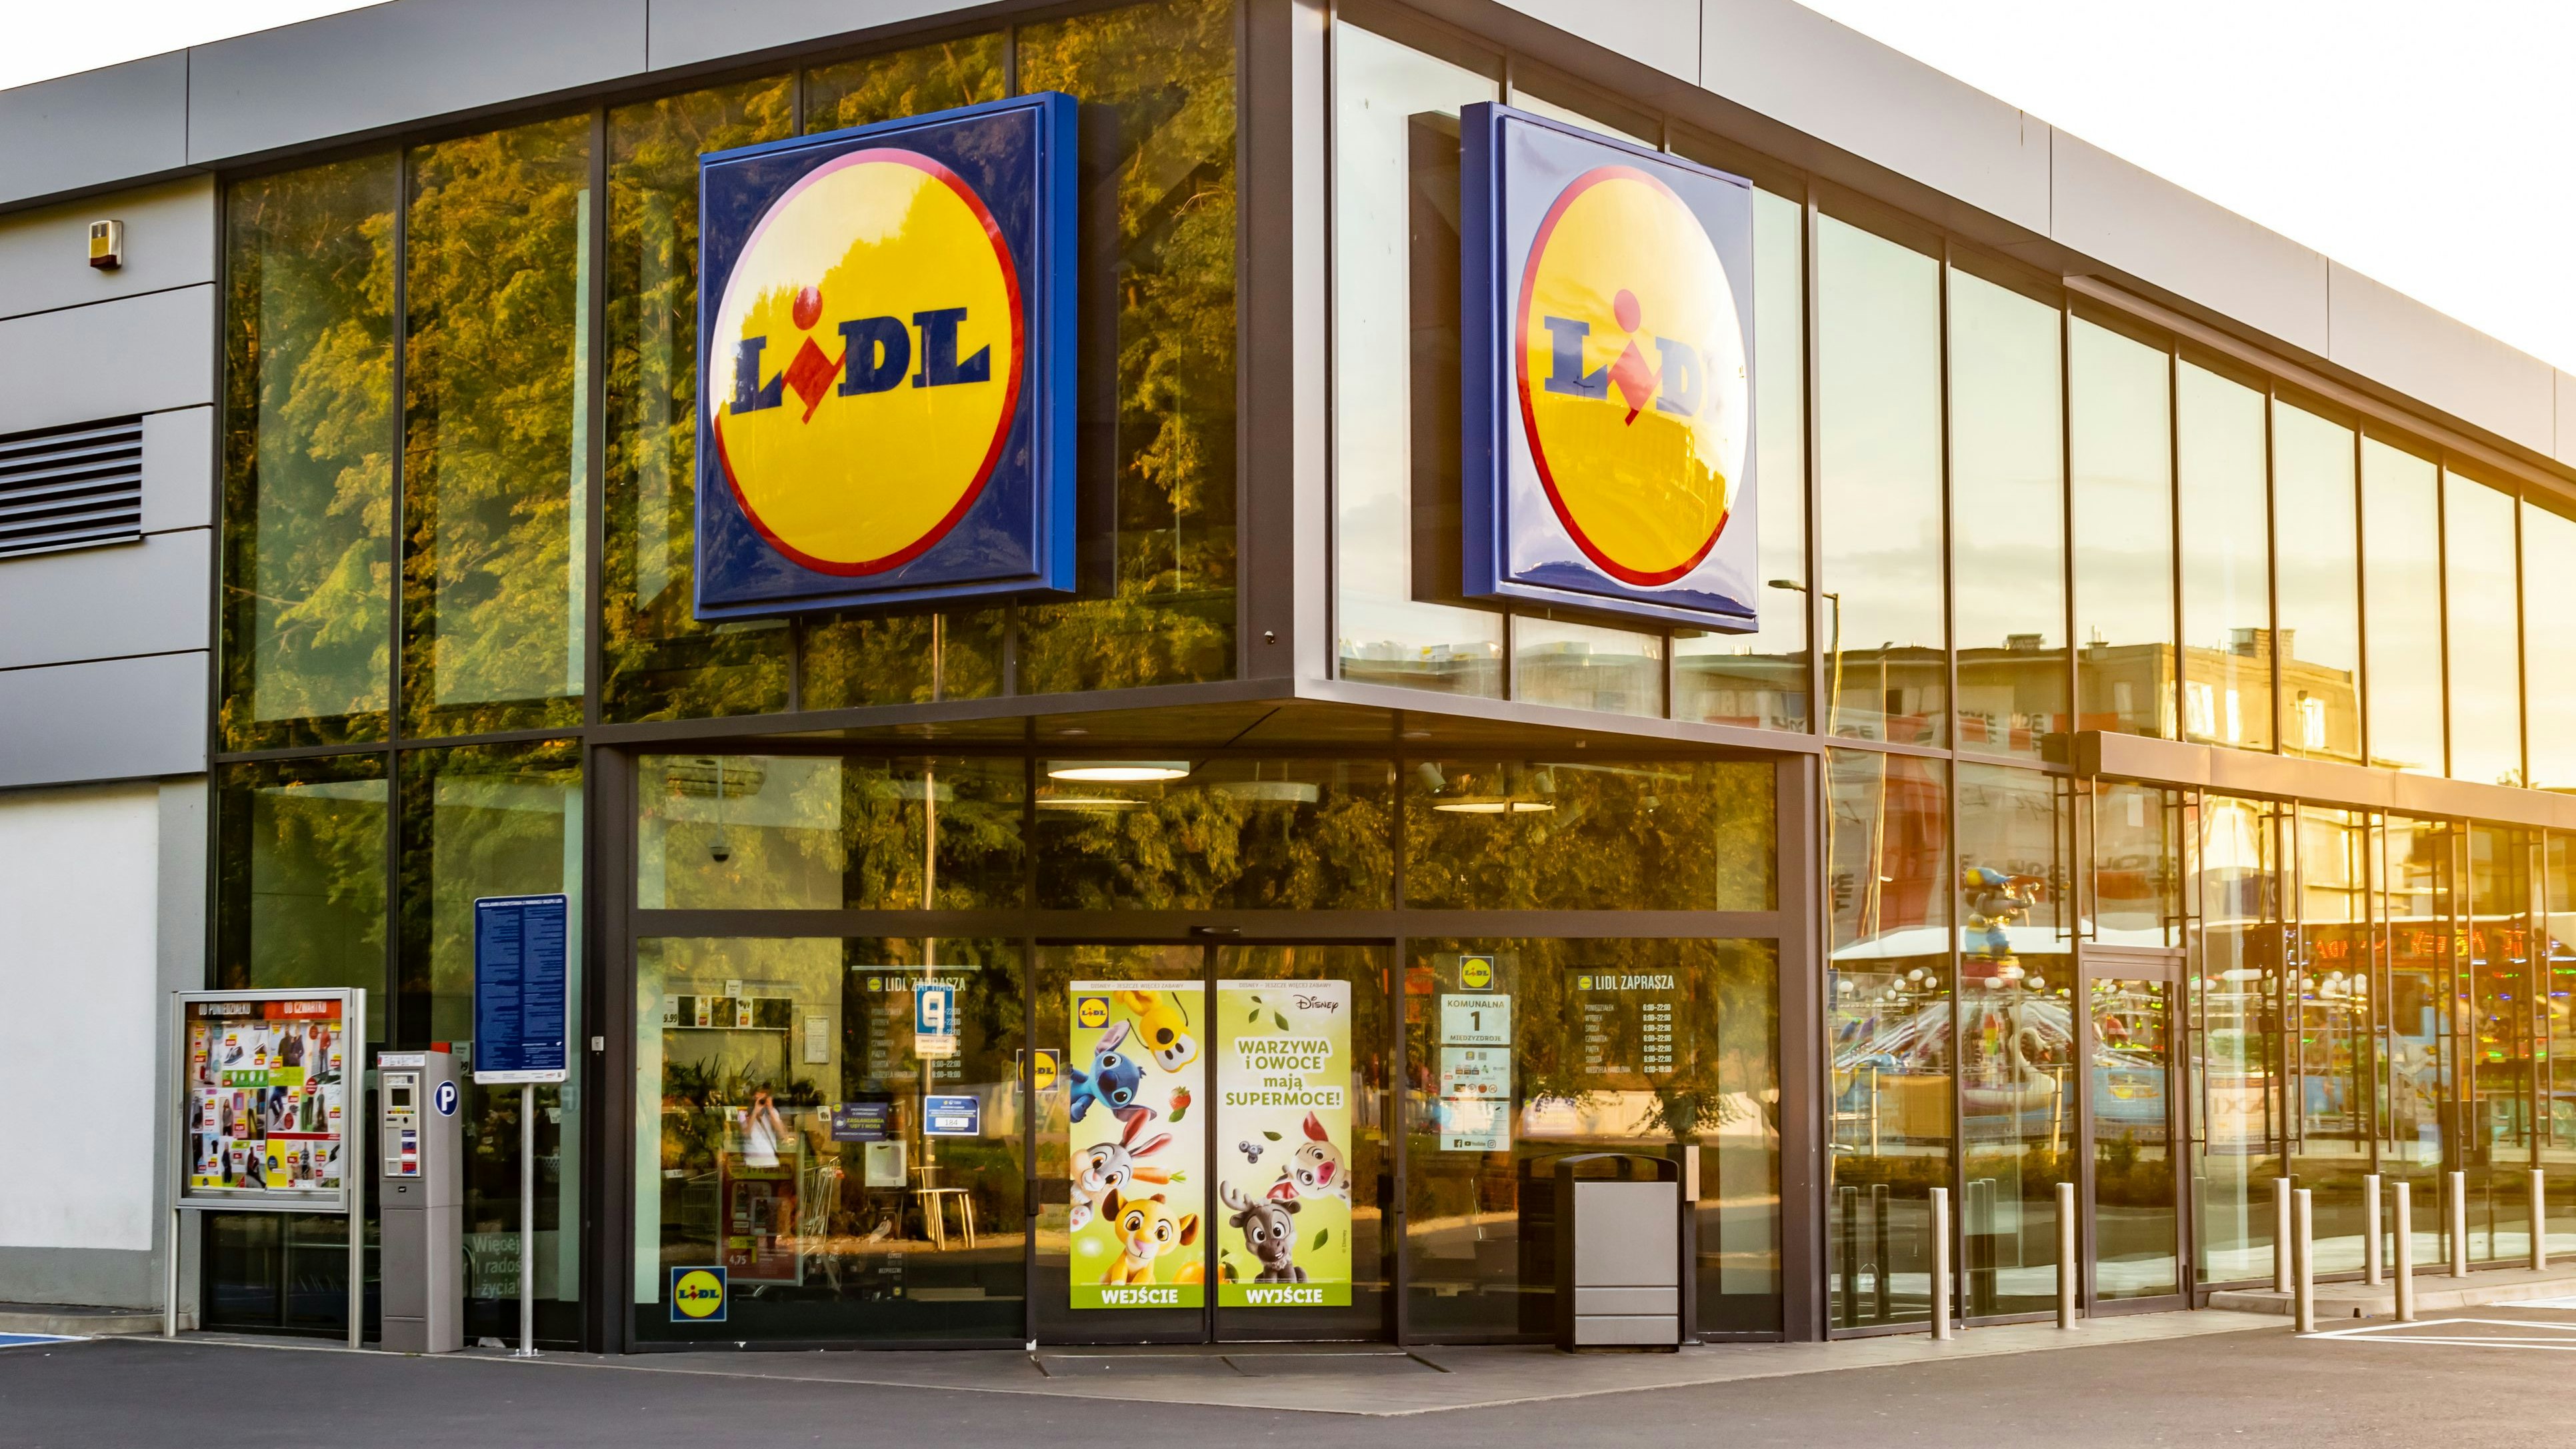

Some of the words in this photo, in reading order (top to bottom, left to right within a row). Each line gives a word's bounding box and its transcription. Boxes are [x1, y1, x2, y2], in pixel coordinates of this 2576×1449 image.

[1544, 289, 1723, 427] LID
[885, 978, 907, 992] LIDL
[1595, 976, 1618, 990] LIDL
[1621, 975, 1675, 990] ZAPRASZA
[1447, 1000, 1505, 1008] KOMUNALNA
[1471, 1011, 1480, 1032] 1
[1450, 1034, 1501, 1042] MIĘDZYZDROJE
[1239, 1040, 1329, 1054] WARZYWA
[1245, 1056, 1251, 1069] i
[1255, 1056, 1321, 1070] OWOCE
[1264, 1074, 1303, 1090] mają
[441, 1086, 455, 1111] P
[1226, 1092, 1340, 1106] SUPERMOCE!
[473, 1236, 521, 1256] Więcej
[729, 1255, 747, 1266] 4,75
[481, 1279, 521, 1299] życia!
[1101, 1287, 1179, 1304] WEJŚCIE
[1246, 1286, 1323, 1304] WYJŚCIE
